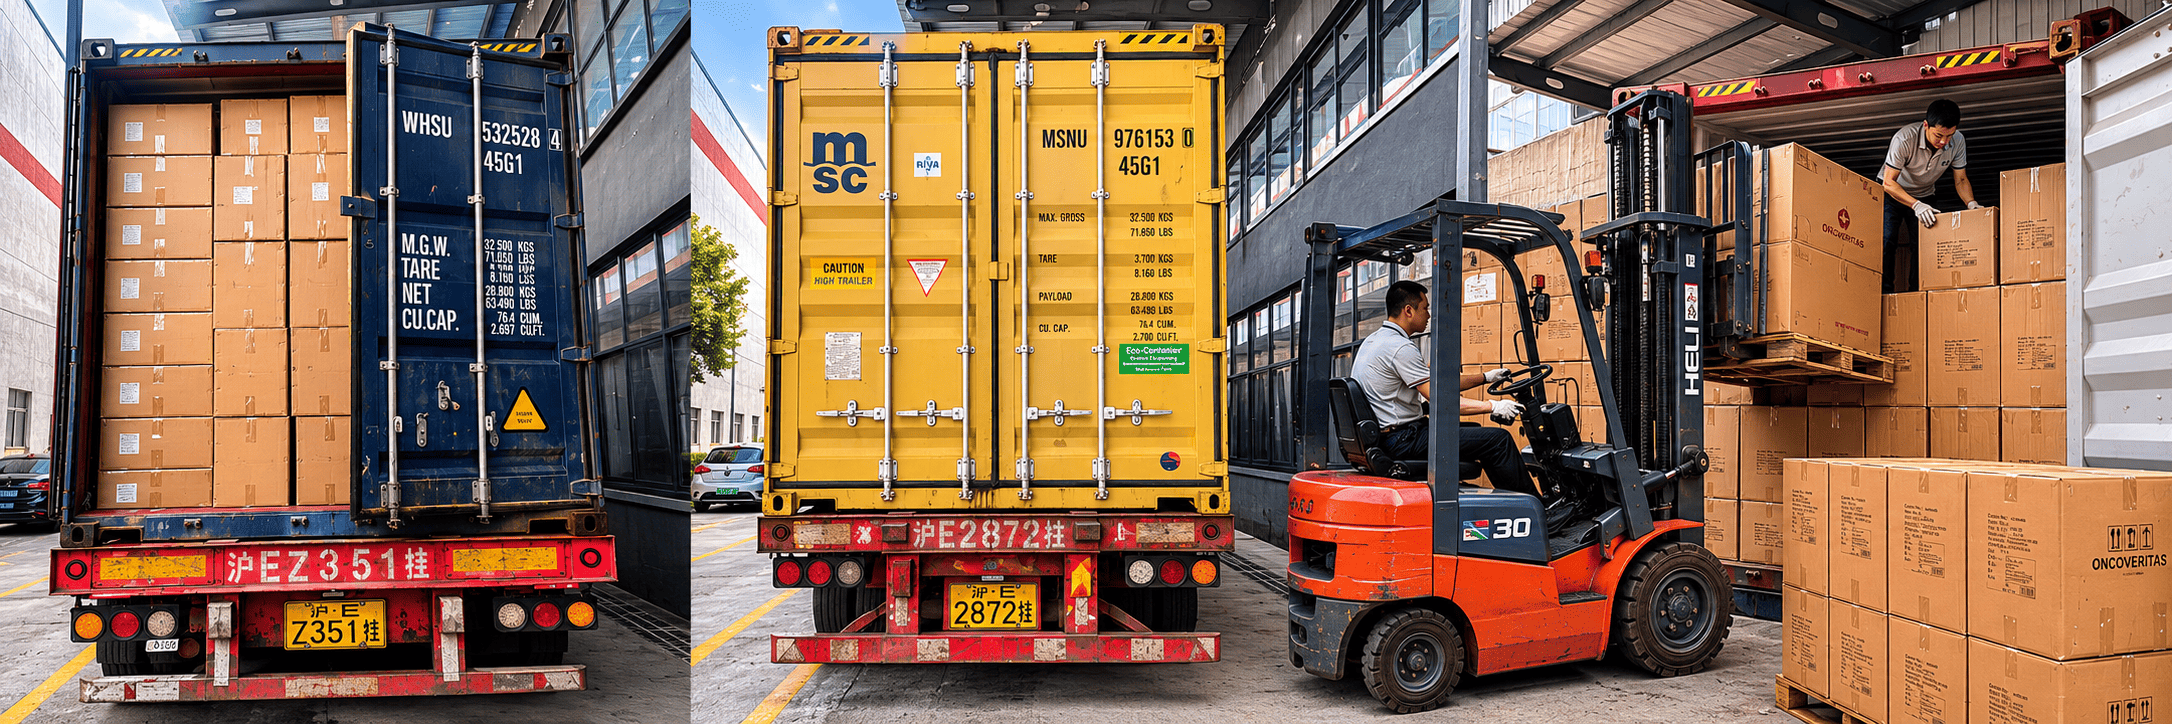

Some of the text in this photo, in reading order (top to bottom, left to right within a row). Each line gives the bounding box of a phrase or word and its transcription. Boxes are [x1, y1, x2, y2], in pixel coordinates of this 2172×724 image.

[402, 110, 561, 150] WHSU 532528 4
[1043, 128, 1193, 148] MSNU 976153 0
[484, 150, 522, 174] 45G1
[1119, 155, 1159, 175] 45G1
[1038, 213, 1085, 222] MAX. GROSS
[1158, 227, 1173, 237] LBS
[402, 233, 450, 257] M.G.W.
[518, 253, 535, 265] LBS
[1038, 254, 1057, 263] TARE
[1134, 253, 1173, 263] 3.700 KGS
[401, 257, 441, 280] TARE
[823, 262, 864, 273] CAUTION
[1158, 268, 1172, 278] LBS
[814, 277, 873, 285] HIGH TRAILER
[402, 282, 432, 305] NET
[1038, 292, 1072, 301] PAYLOAD
[520, 299, 536, 310] LBS
[402, 308, 460, 332] CU.CAP.
[491, 323, 515, 335] 2.697
[1053, 324, 1070, 333] CAP.
[1685, 326, 1699, 395] HELI
[1492, 518, 1531, 539] 30
[2092, 554, 2167, 570] ONCOVERITAS
[954, 600, 1032, 624] 2872挂
[292, 619, 380, 645] Z351挂
